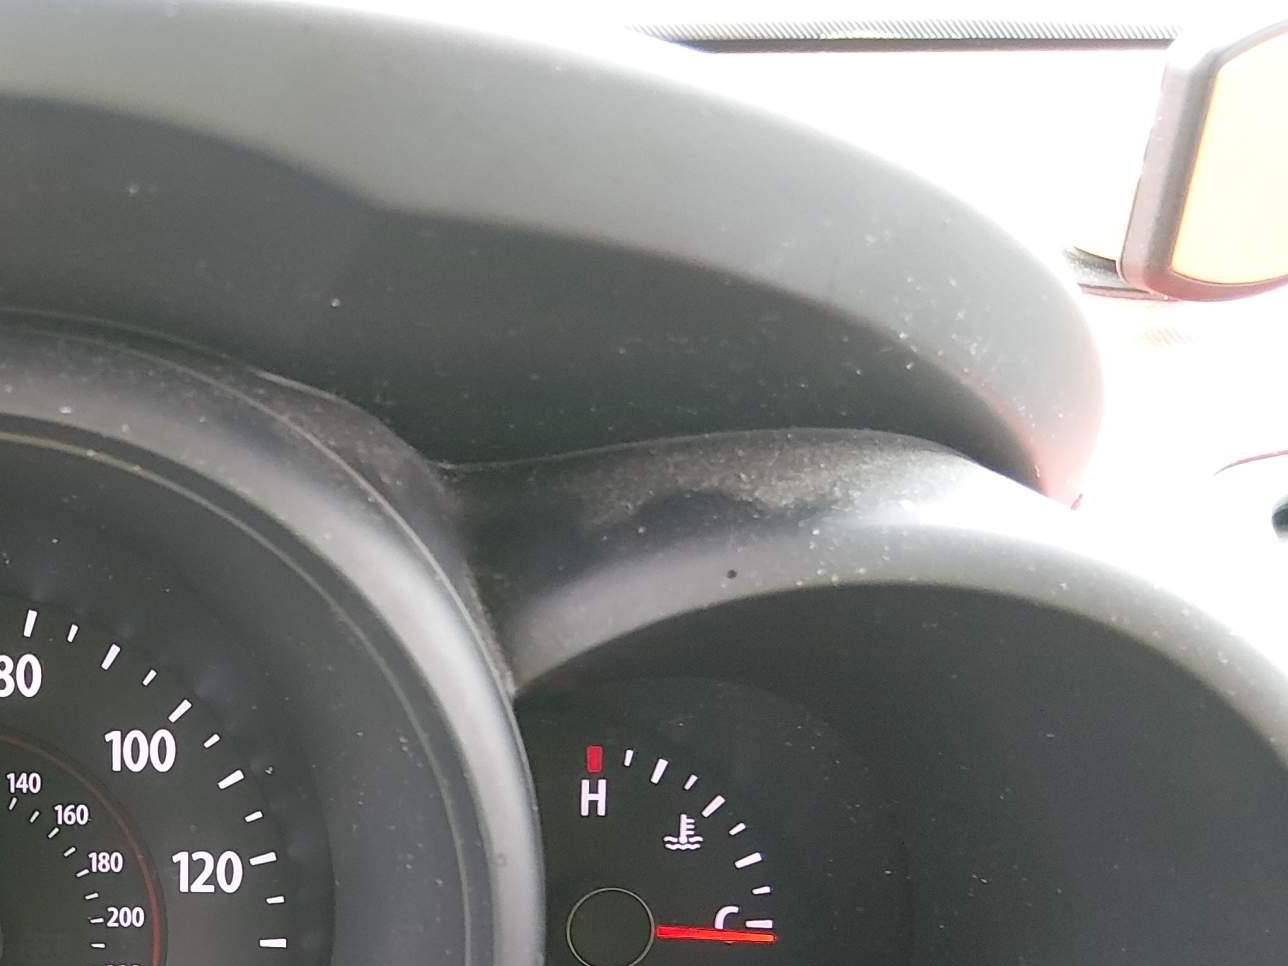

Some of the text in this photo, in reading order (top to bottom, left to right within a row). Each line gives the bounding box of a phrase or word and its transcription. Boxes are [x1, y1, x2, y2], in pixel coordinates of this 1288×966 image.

[104, 728, 177, 773] 100
[6, 772, 42, 794] 140
[580, 778, 607, 817] H
[54, 804, 89, 826] 160
[86, 851, 124, 874] 180
[170, 850, 244, 894] 120
[106, 906, 145, 928] 200
